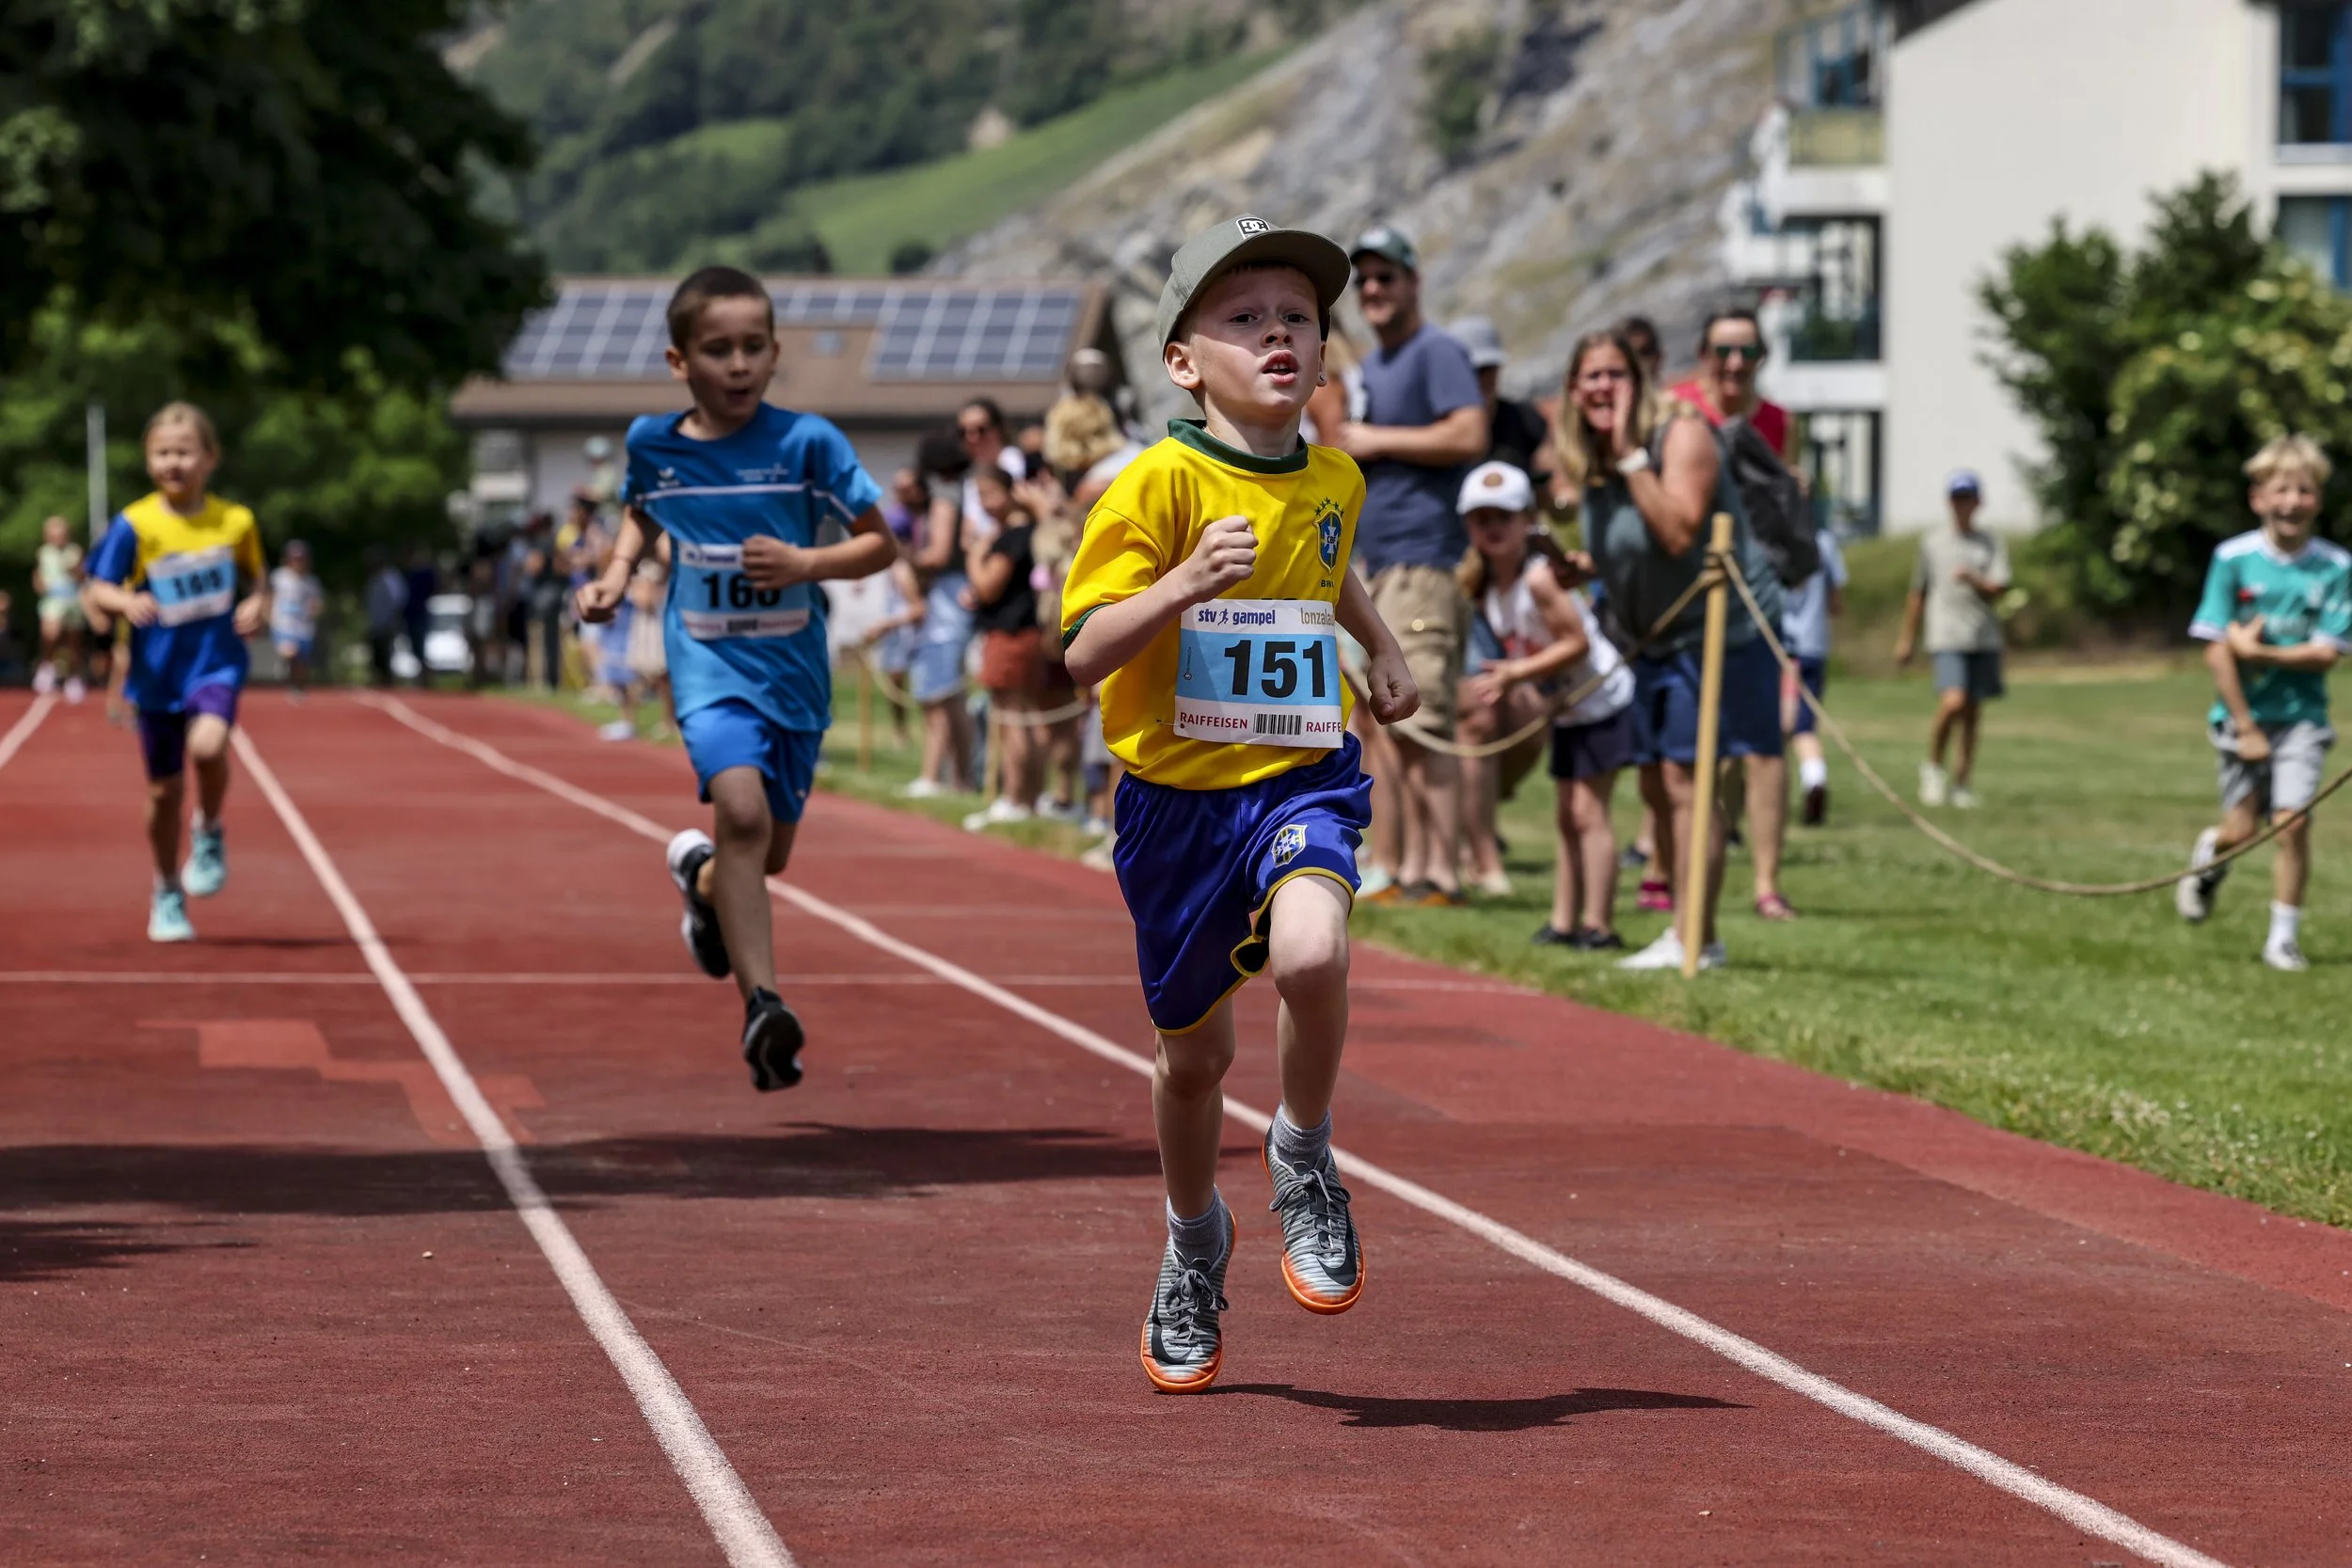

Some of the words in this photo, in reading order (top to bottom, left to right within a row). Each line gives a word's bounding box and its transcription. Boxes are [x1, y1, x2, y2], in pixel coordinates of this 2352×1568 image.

[1198, 609, 1216, 623] stv
[1232, 610, 1276, 626] gampel
[1224, 640, 1326, 698] 151
[1180, 711, 1248, 729] RAIFFEISEN
[1306, 721, 1342, 732] RAIFFE
